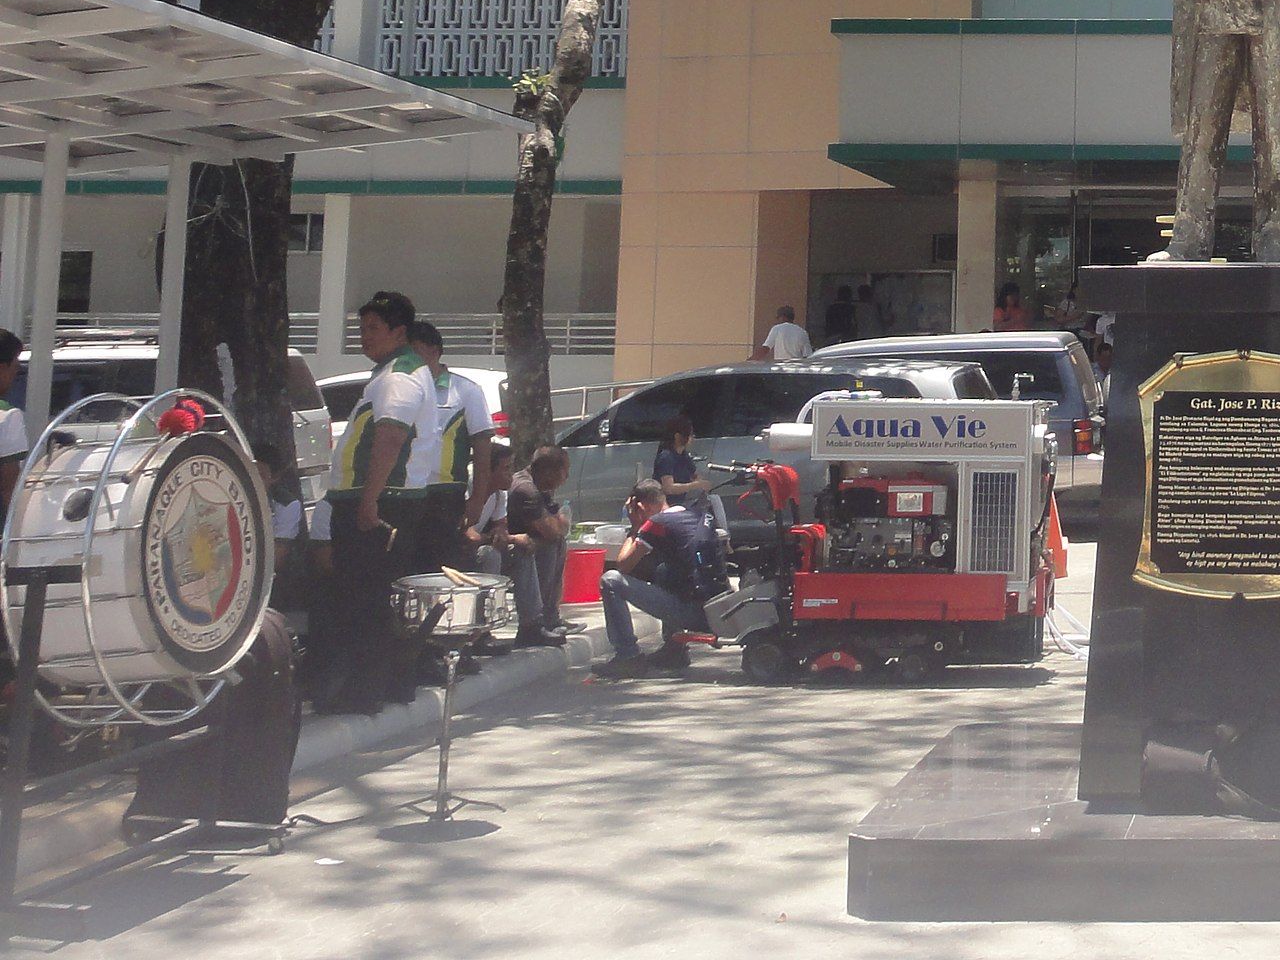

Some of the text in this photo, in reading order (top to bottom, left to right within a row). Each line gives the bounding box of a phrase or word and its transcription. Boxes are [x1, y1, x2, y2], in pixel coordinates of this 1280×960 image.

[1190, 397, 1217, 410] Gat.
[1218, 398, 1244, 412] Jose
[1246, 398, 1258, 410] P.
[826, 414, 987, 439] Aqua Vie
[826, 440, 1017, 451] Mobile Disaster Supplies Water Purification System
[190, 461, 224, 480] CITY
